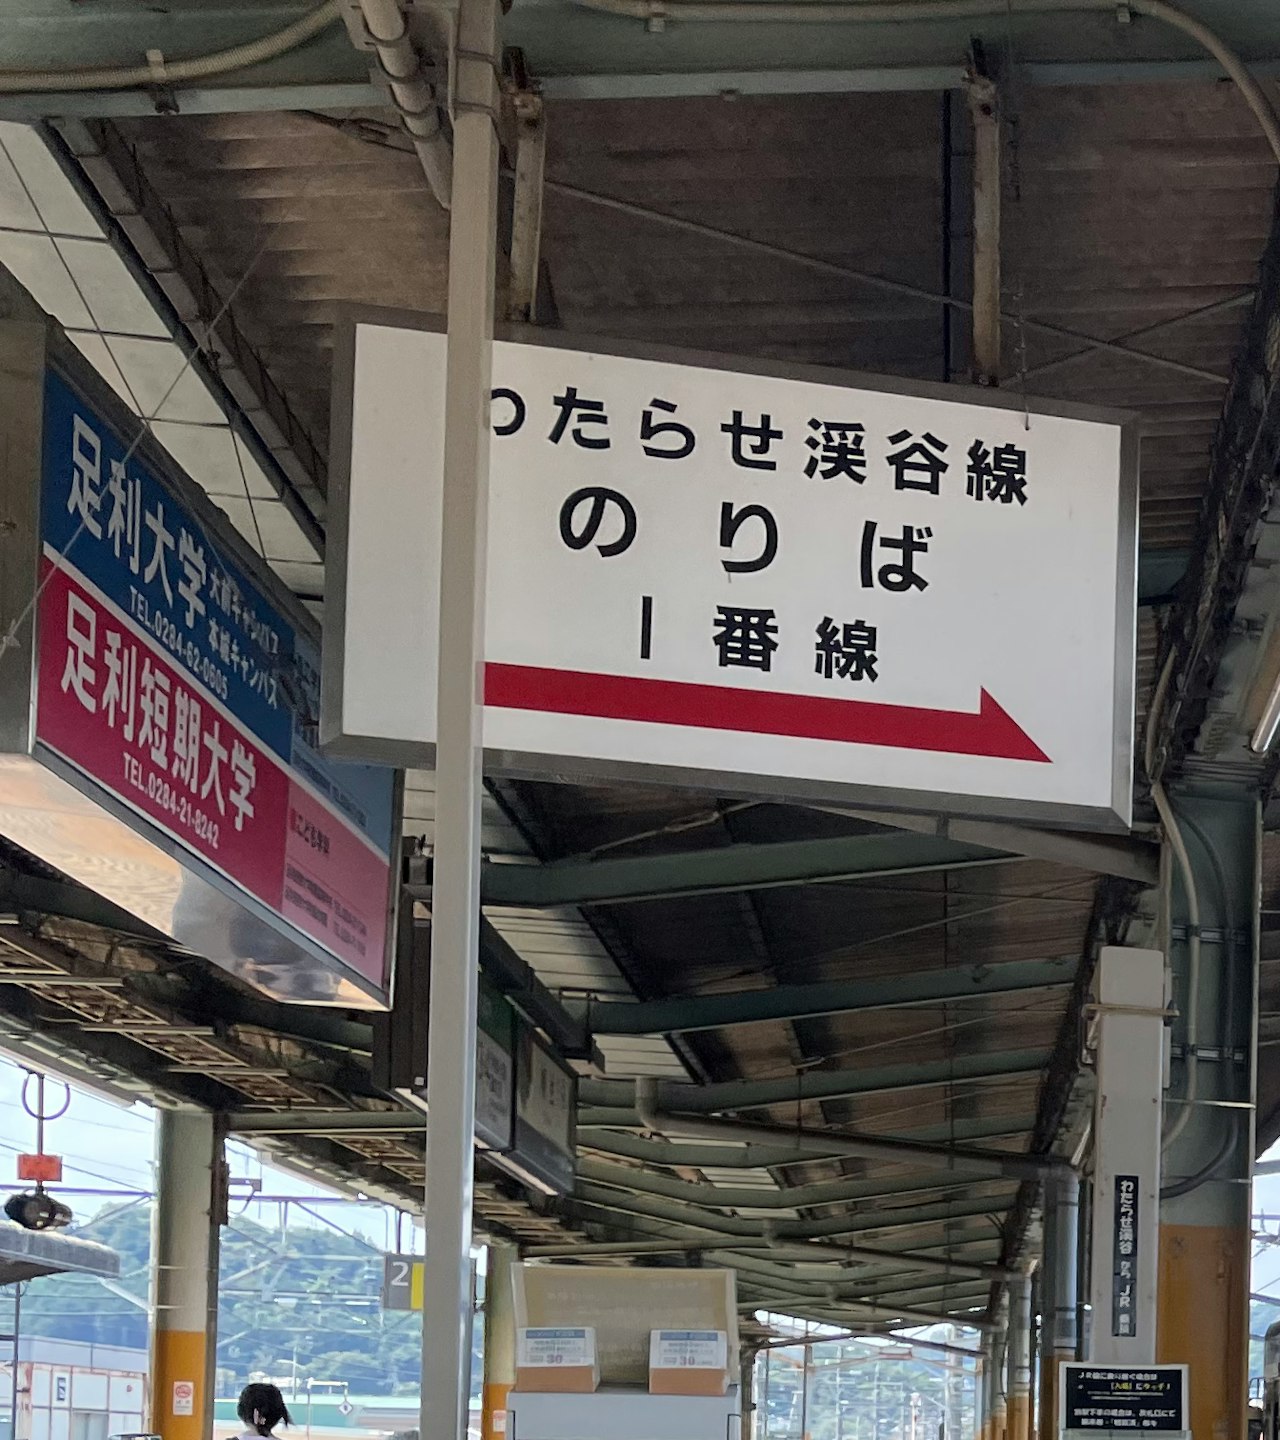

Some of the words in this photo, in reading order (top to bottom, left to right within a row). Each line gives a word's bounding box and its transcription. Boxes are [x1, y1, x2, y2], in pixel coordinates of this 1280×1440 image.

[67, 413, 206, 629] 足利大学
[559, 486, 933, 592] のりば
[640, 596, 879, 682] 1番線
[61, 590, 256, 831] 足利短期大学
[123, 752, 219, 849] TEL.0284-21-8242
[391, 1261, 409, 1287] 2
